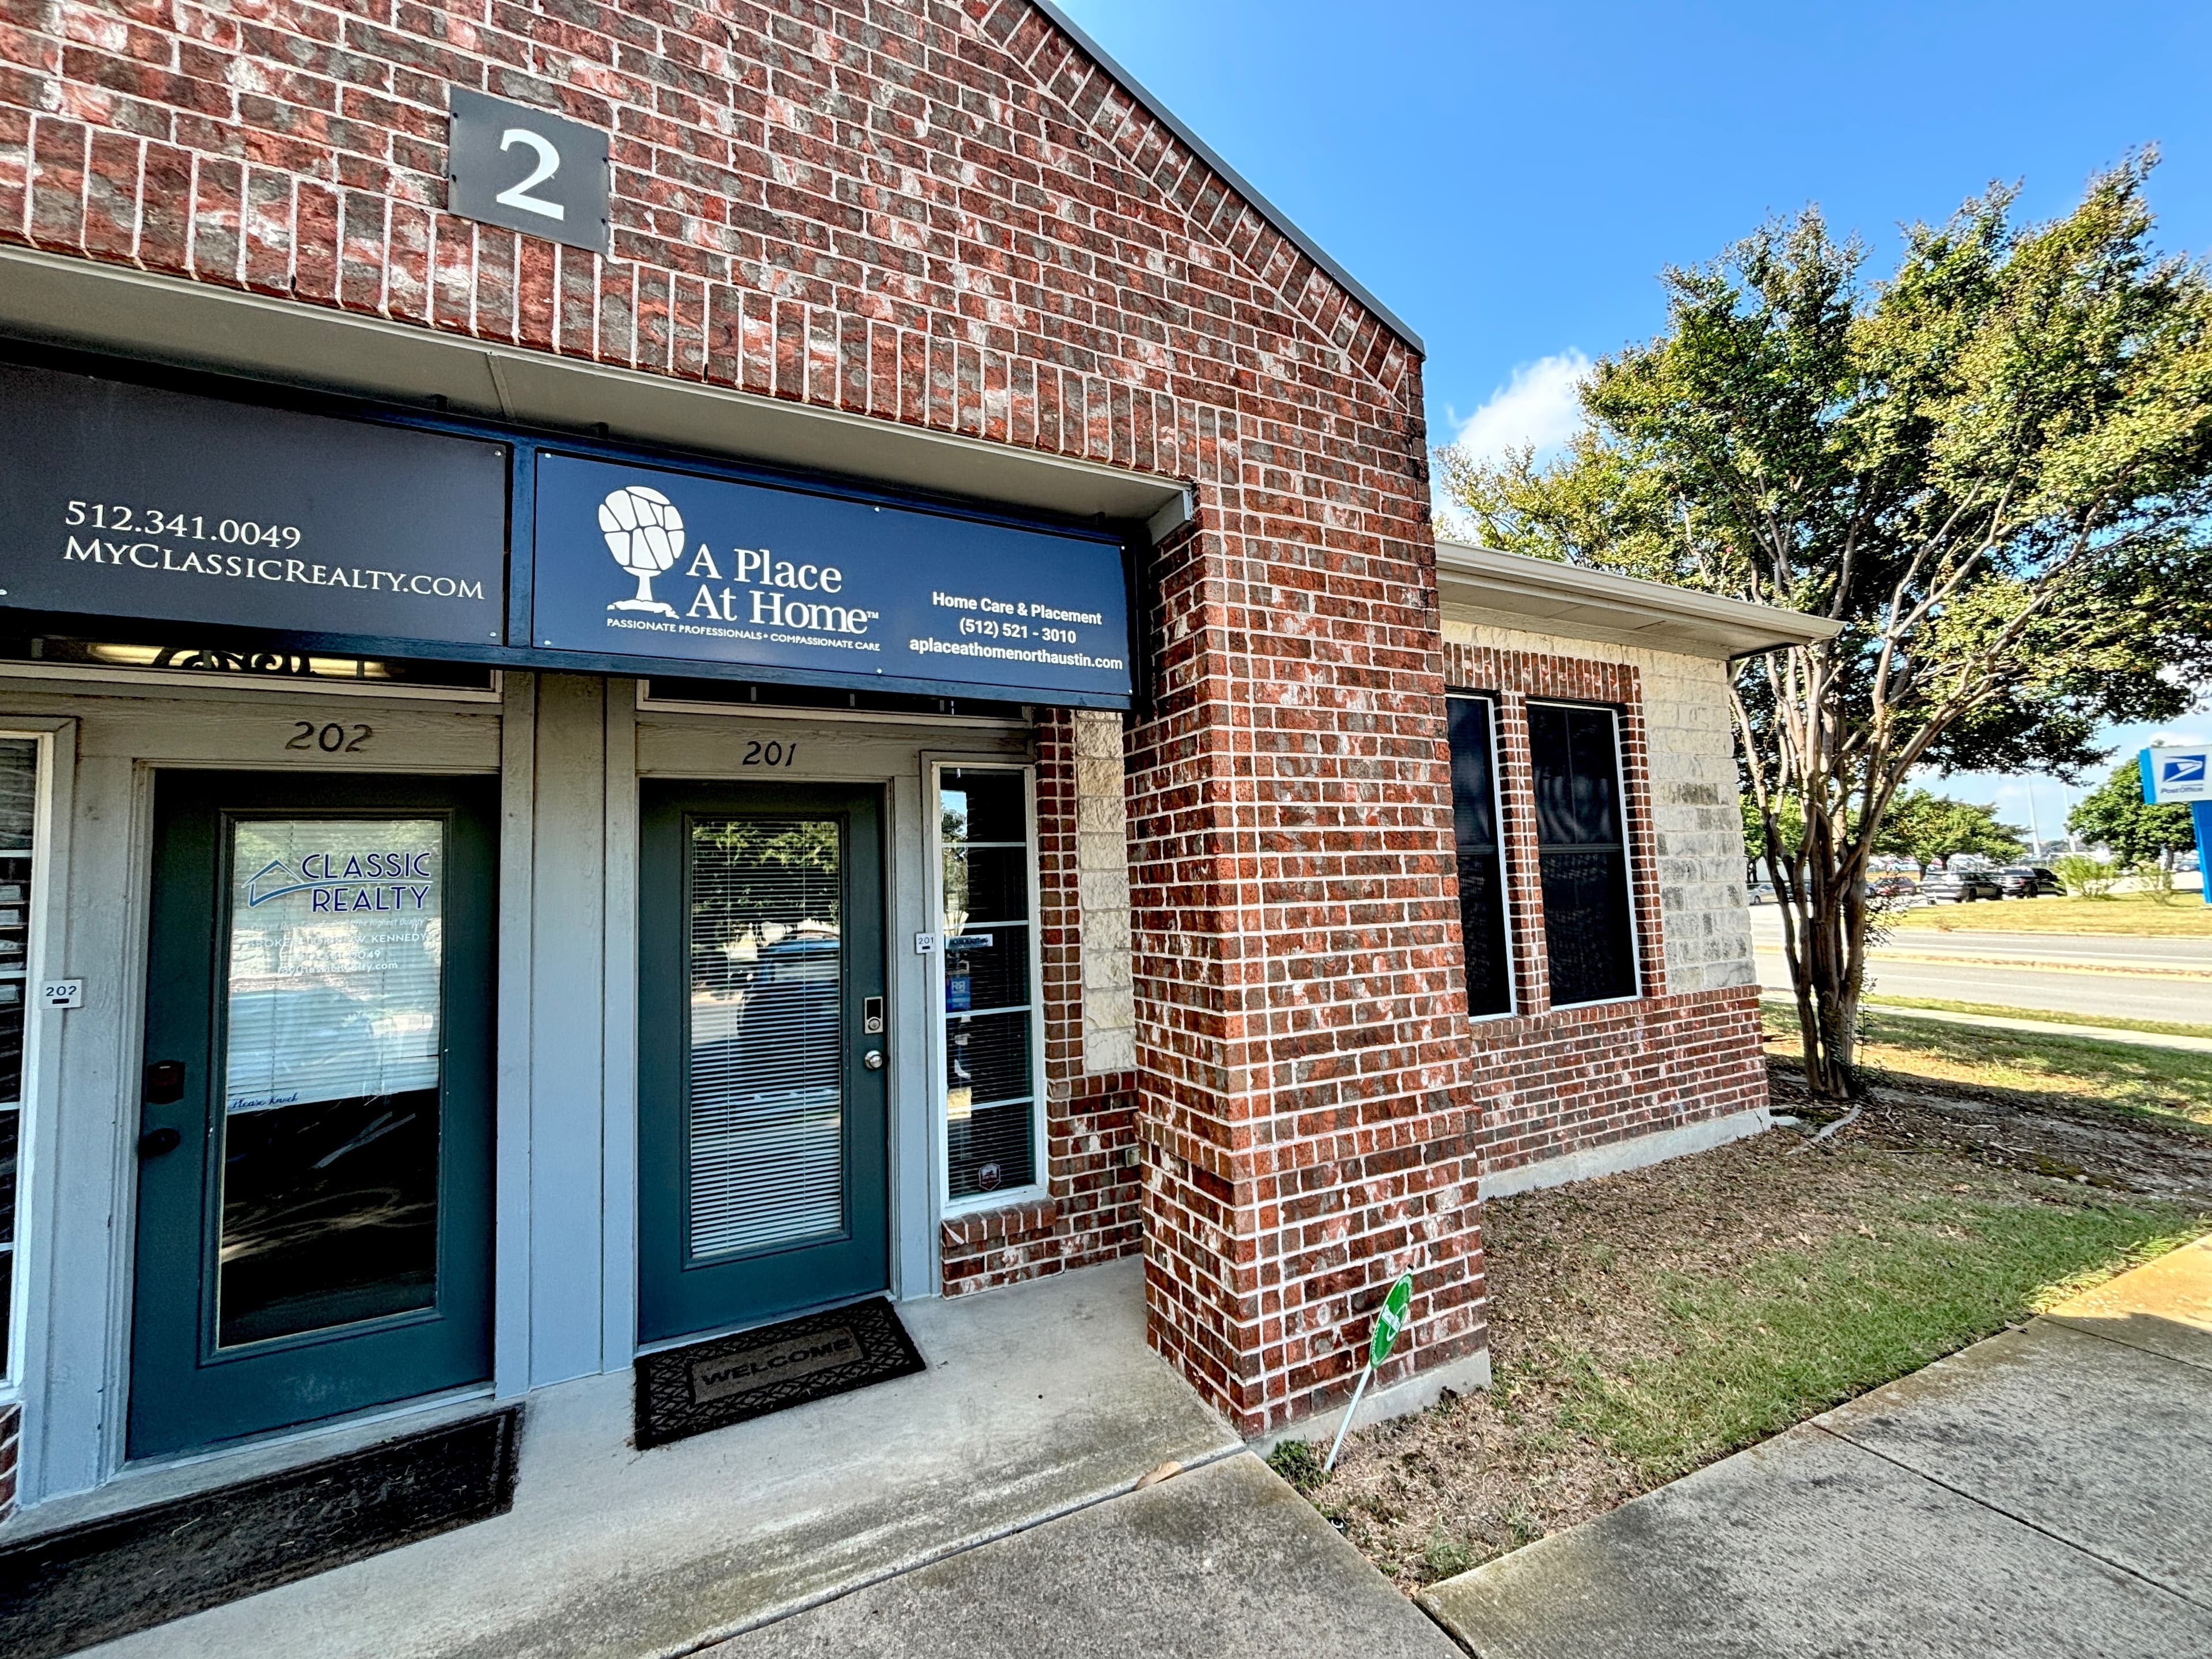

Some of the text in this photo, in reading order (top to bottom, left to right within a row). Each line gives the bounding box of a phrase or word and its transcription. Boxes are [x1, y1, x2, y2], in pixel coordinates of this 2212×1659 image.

[497, 129, 564, 221] 2
[65, 501, 301, 550] 512.341.0049
[686, 544, 842, 593] A Place
[686, 584, 737, 622] At
[933, 592, 1103, 626] Home Care & Placement
[607, 618, 677, 632] PASSIONATE
[770, 633, 854, 650] COMPASSIONATE
[855, 641, 881, 652] CARE
[960, 618, 999, 639] (512)
[1002, 623, 1028, 639] 521
[1041, 627, 1077, 644] 3010
[909, 637, 1123, 670] aplaceathomenorthaustin.com
[285, 721, 373, 752] 202
[742, 741, 797, 767] 201
[301, 851, 431, 880] CLASSIC
[312, 885, 431, 913] REALTY
[248, 937, 304, 948] BROKE
[372, 933, 427, 943] KENNEDY
[918, 937, 934, 945] 201
[46, 985, 77, 997] 202
[232, 1097, 266, 1108] Please
[700, 1338, 853, 1385] WELCOME
